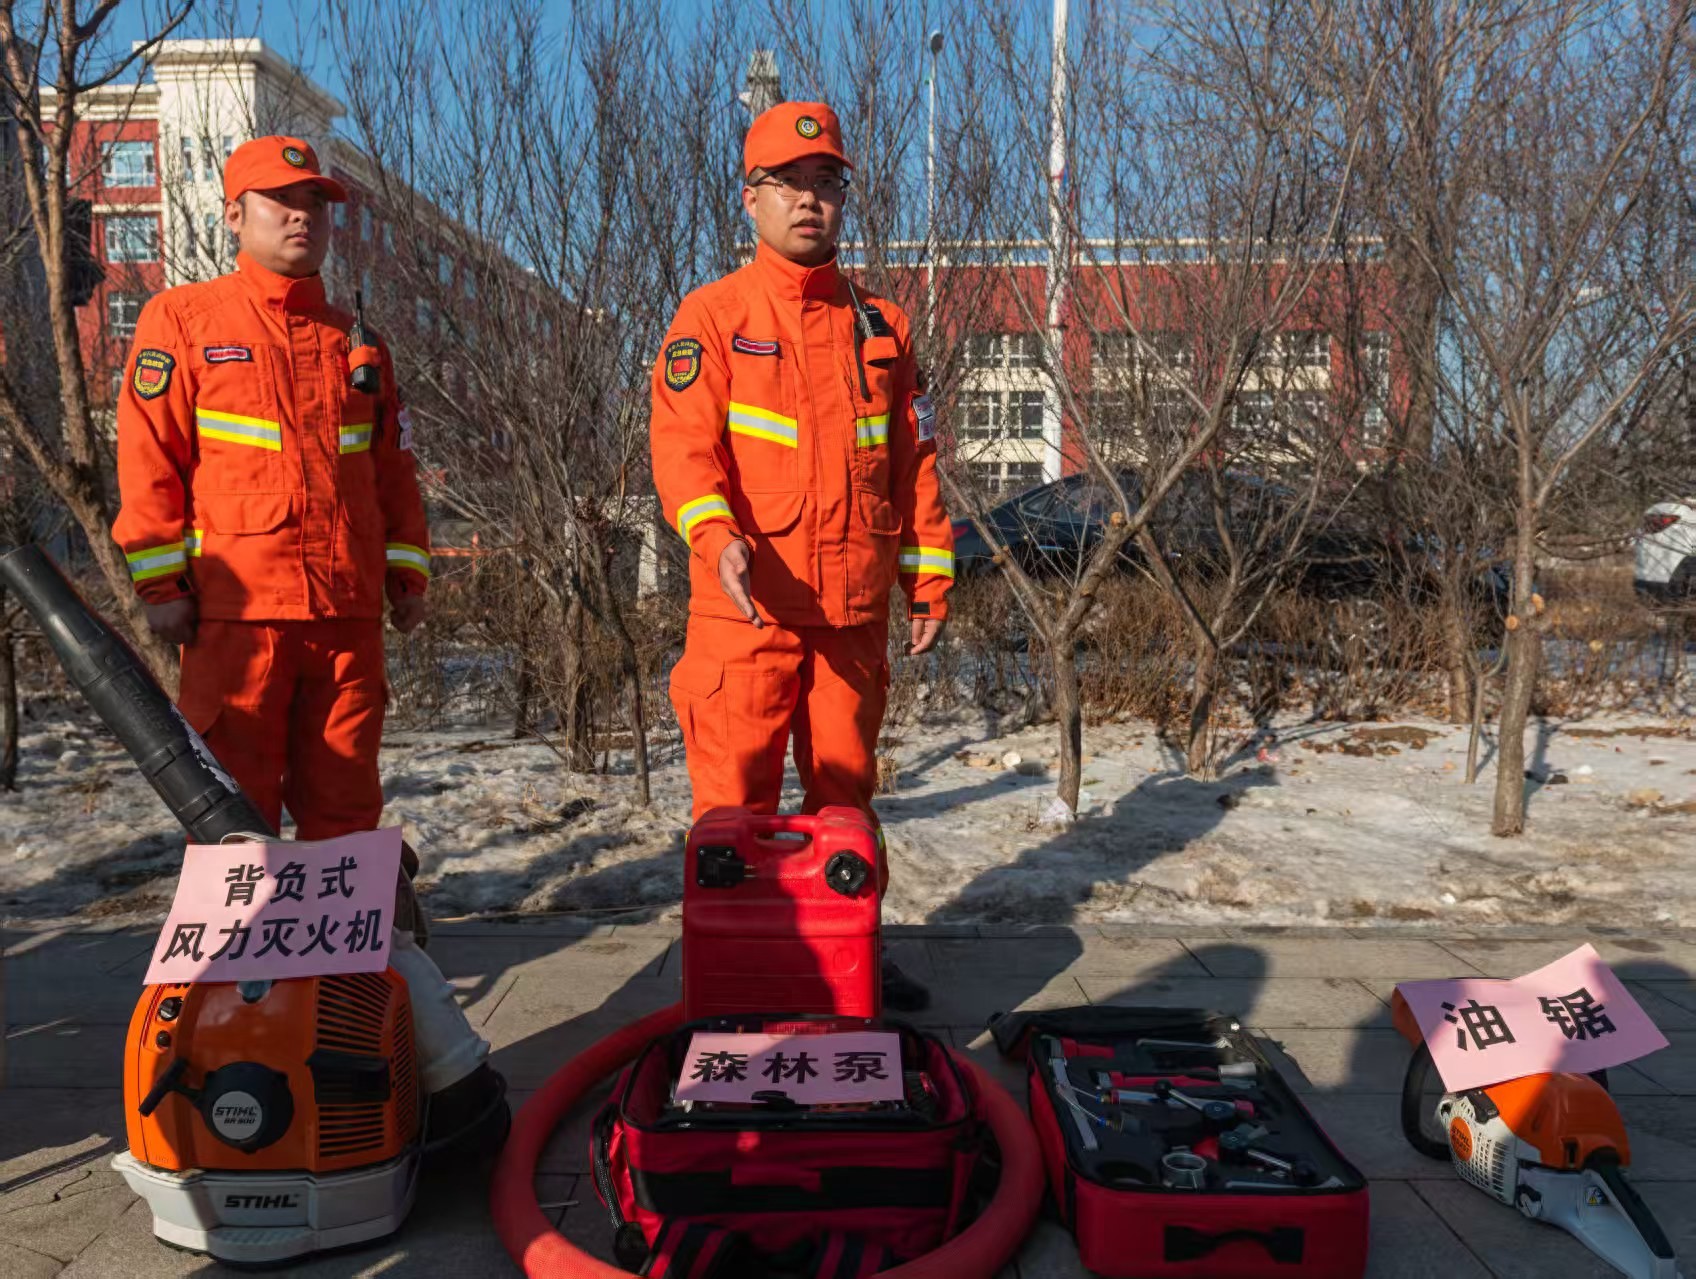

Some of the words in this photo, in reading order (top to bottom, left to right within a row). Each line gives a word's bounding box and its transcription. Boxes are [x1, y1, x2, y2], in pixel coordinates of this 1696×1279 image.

[224, 856, 358, 907] 背负式
[160, 908, 384, 963] 风力灭火机
[1440, 987, 1617, 1051] 油锯
[689, 1050, 889, 1084] 森林泵
[214, 1106, 257, 1116] STIHL
[224, 1194, 298, 1208] STIHL
